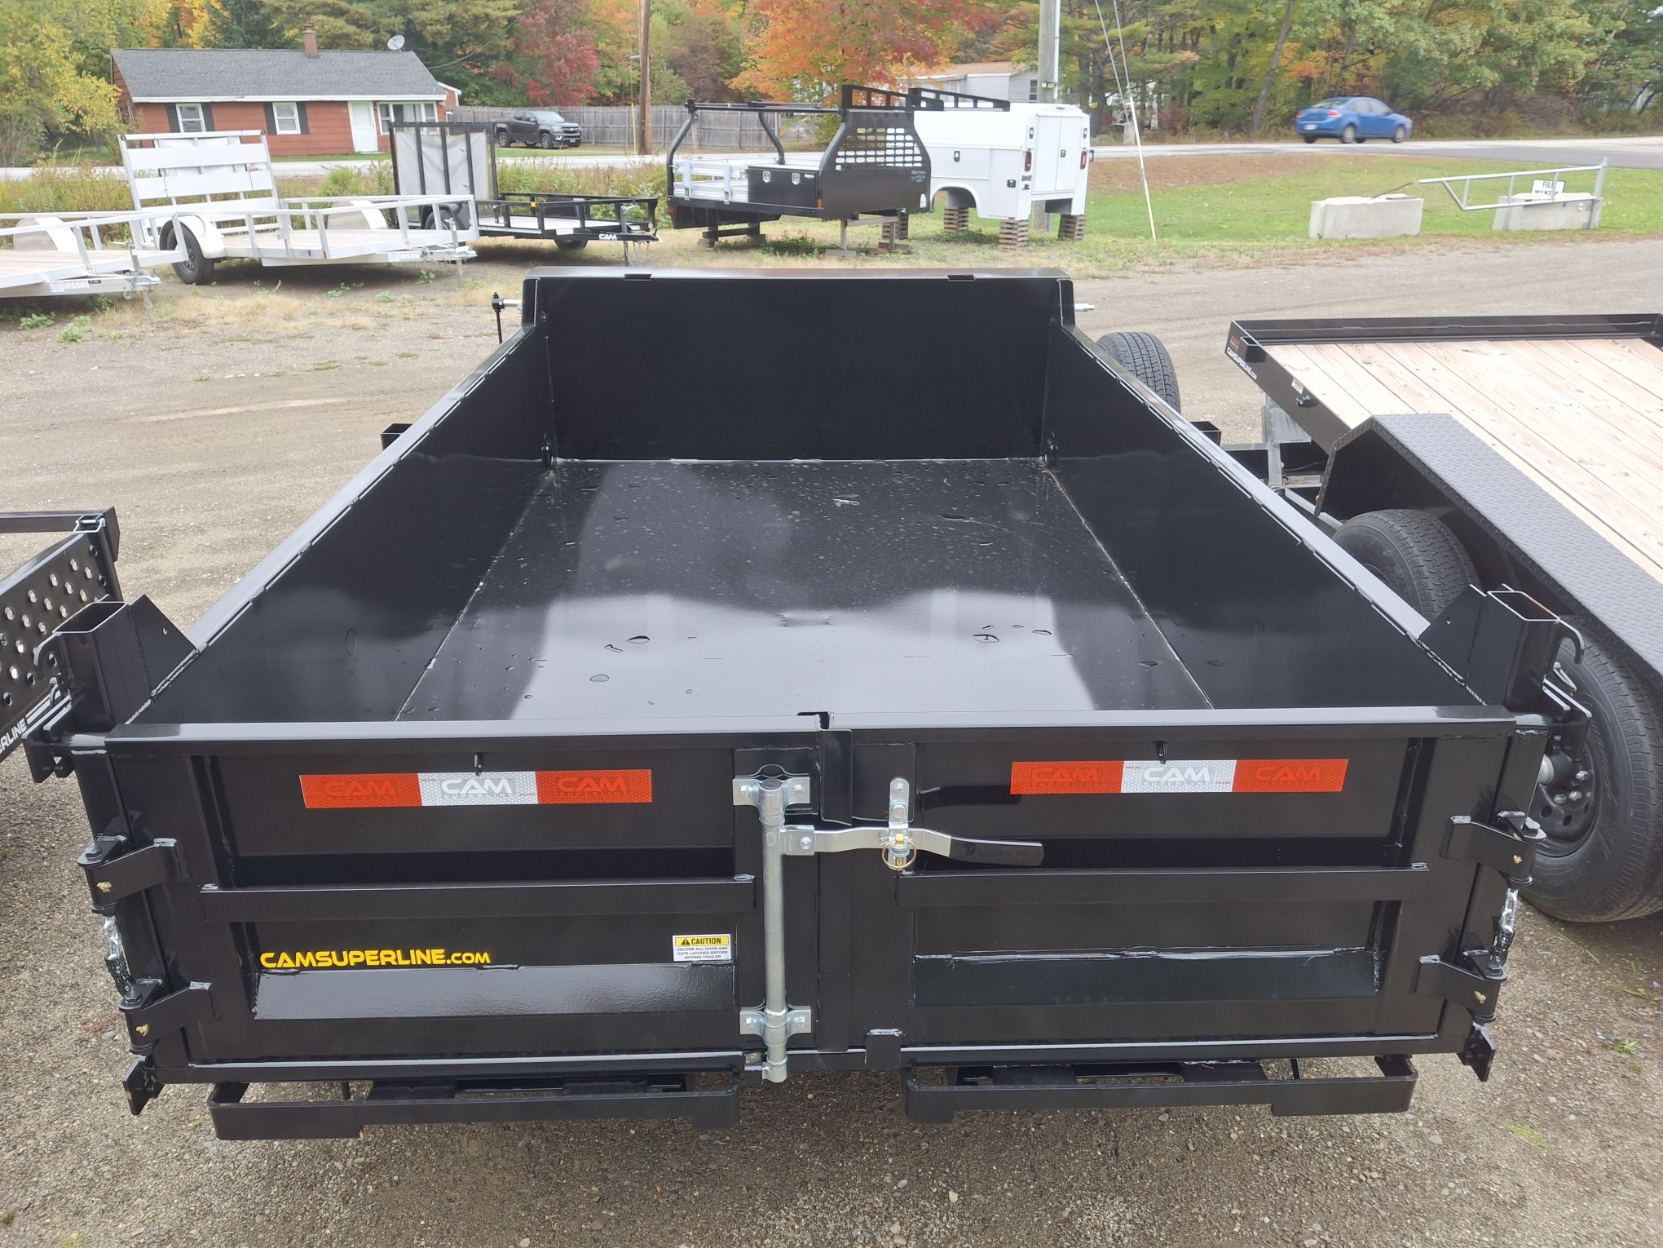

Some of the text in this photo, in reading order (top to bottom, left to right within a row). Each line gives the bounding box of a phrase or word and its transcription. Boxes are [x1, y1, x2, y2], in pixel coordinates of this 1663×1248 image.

[1031, 767, 1099, 783] CAM
[1143, 767, 1210, 782] CAM
[1254, 766, 1321, 781] CAM
[324, 780, 396, 797] CAM
[441, 778, 513, 795] CAM
[557, 776, 627, 792] CAM
